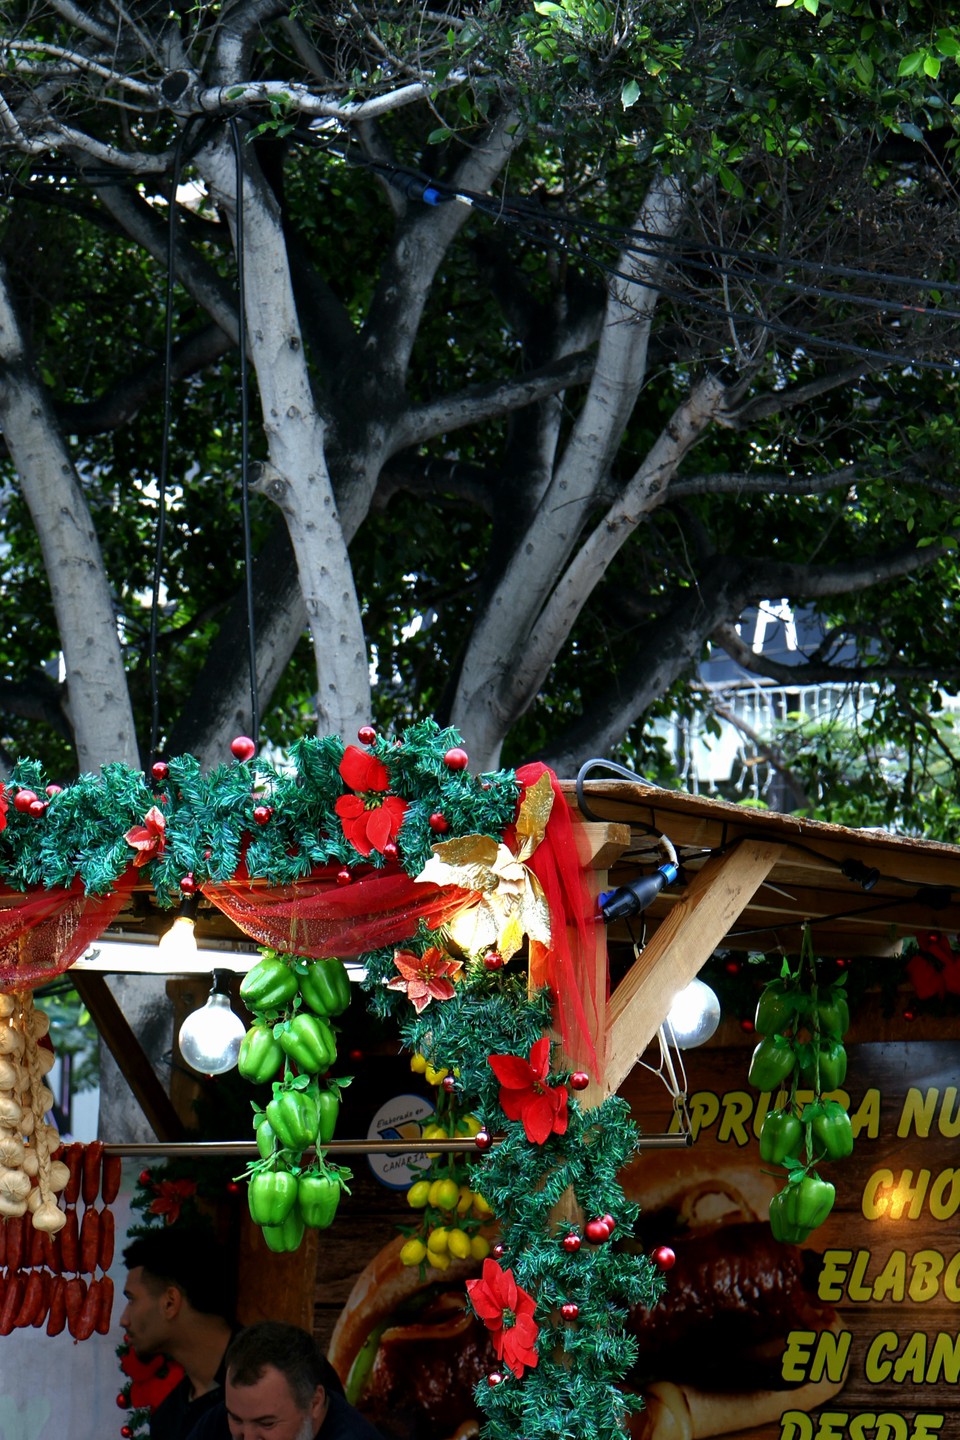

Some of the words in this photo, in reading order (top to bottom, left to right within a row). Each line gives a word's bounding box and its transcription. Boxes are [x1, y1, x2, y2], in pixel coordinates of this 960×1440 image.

[376, 1111, 413, 1129] Elaborado
[383, 1151, 429, 1173] CANARIA
[781, 1331, 852, 1382] EN
[865, 1331, 960, 1384] CAN
